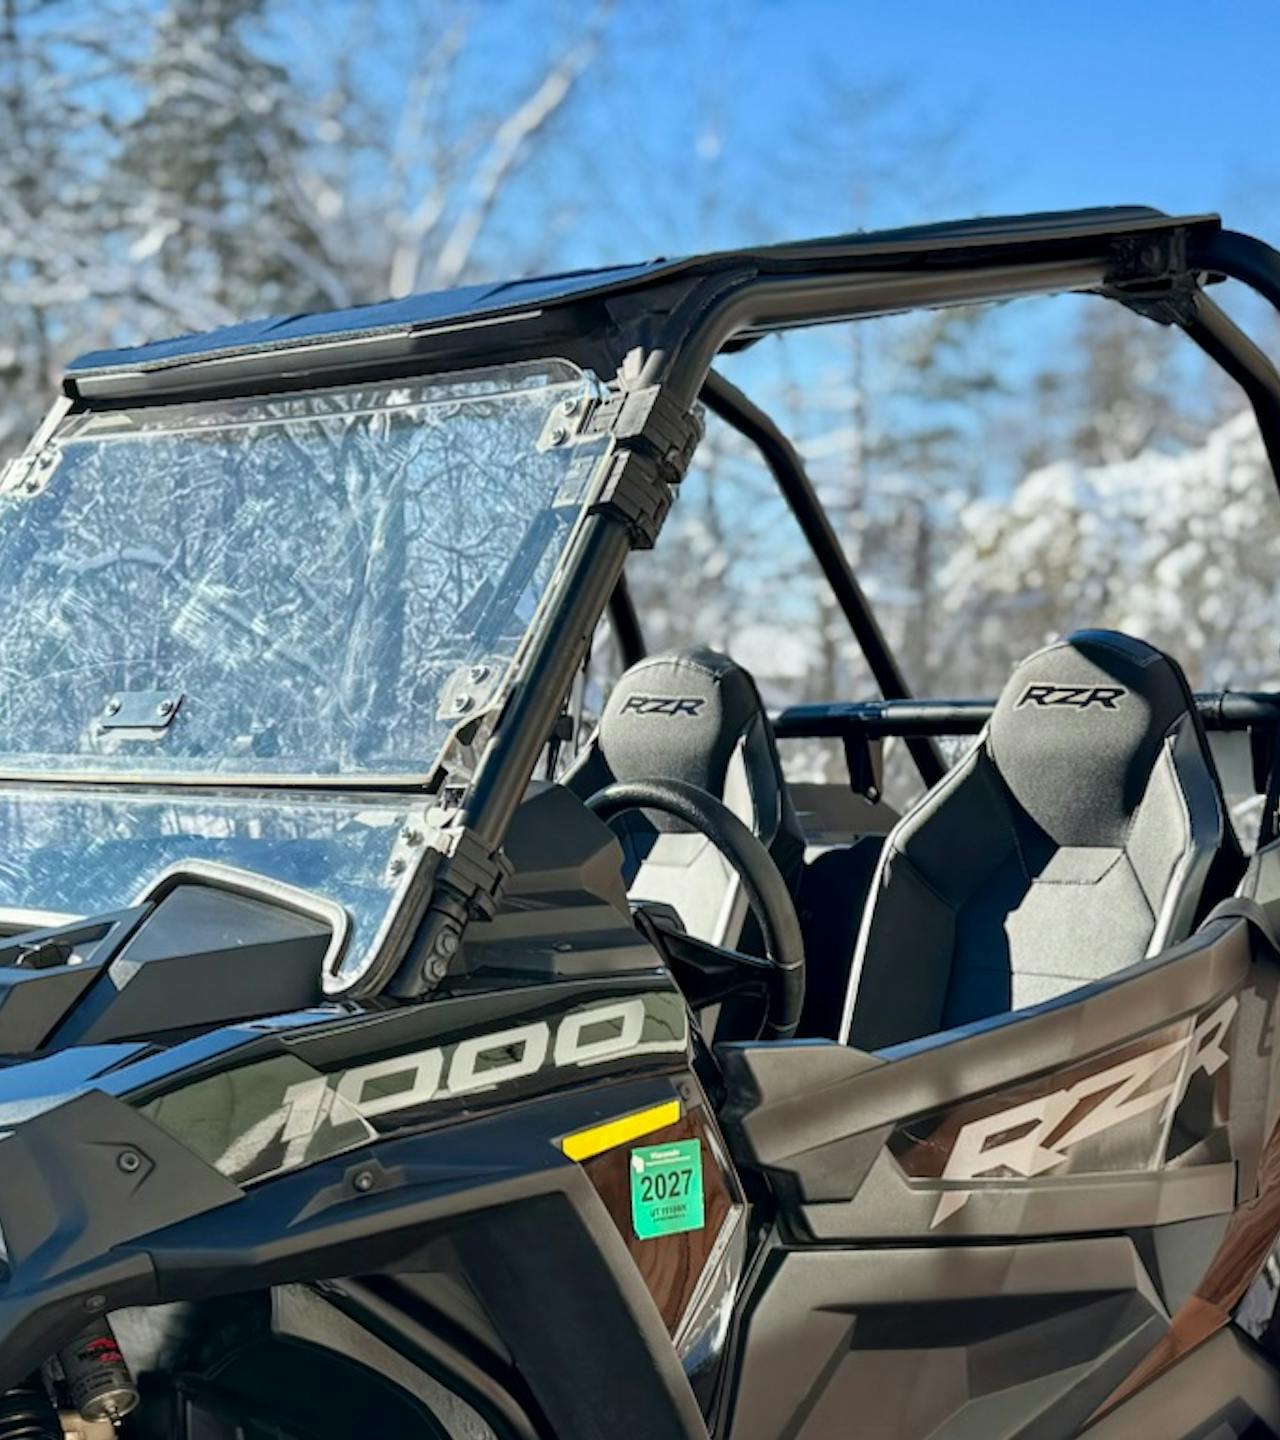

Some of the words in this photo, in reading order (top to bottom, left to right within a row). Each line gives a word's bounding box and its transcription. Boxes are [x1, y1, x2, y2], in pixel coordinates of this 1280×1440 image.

[619, 694, 707, 717] RZR
[1014, 683, 1128, 711] RZR
[278, 1000, 646, 1146] 1000
[930, 995, 1239, 1230] RZR
[640, 1169, 693, 1202] 2027
